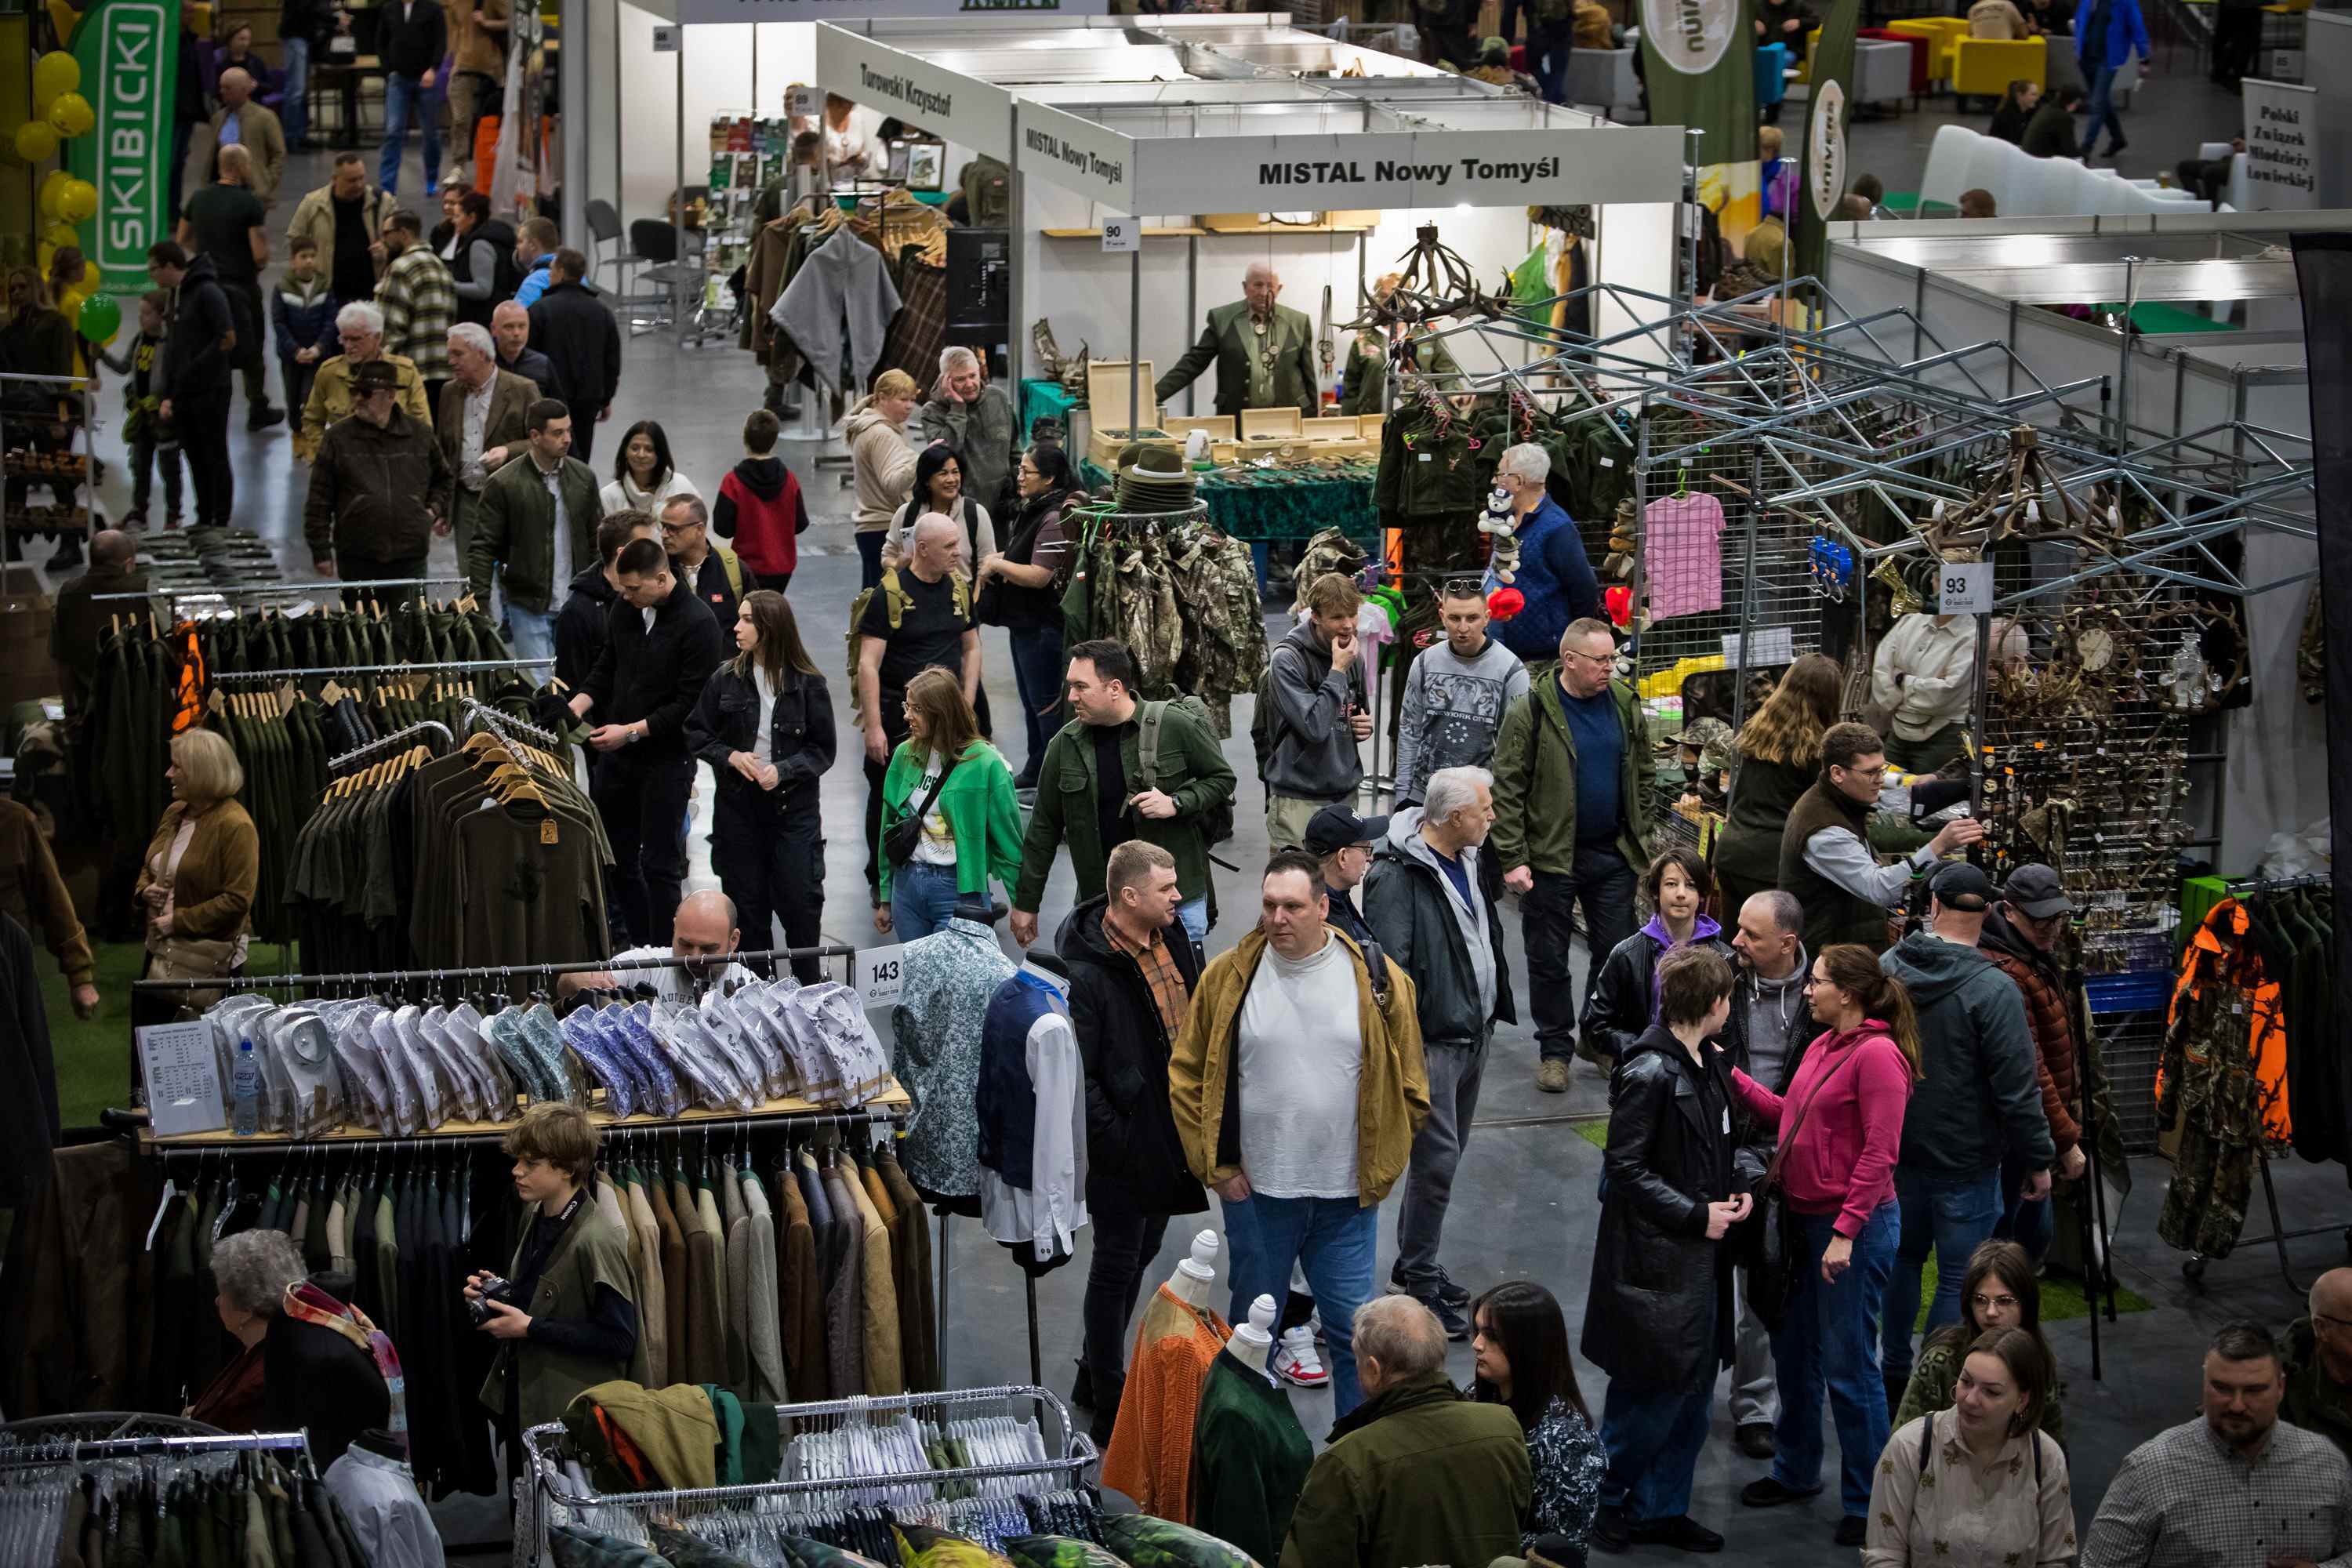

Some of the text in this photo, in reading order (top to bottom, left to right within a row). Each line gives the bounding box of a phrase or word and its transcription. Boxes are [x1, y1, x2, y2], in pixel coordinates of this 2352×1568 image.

[861, 63, 951, 118] Turowski Krzysztof
[2260, 106, 2299, 125] Polski
[111, 23, 151, 249] SKIBICKI
[1026, 128, 1122, 184] MISTAL Nowy Tomyśl
[1259, 157, 1559, 186] MISTAL Nowy Tomyśl
[1106, 226, 1121, 238] 90
[1946, 578, 1965, 593] 93
[872, 960, 898, 983] 143
[561, 1200, 578, 1221] Canon
